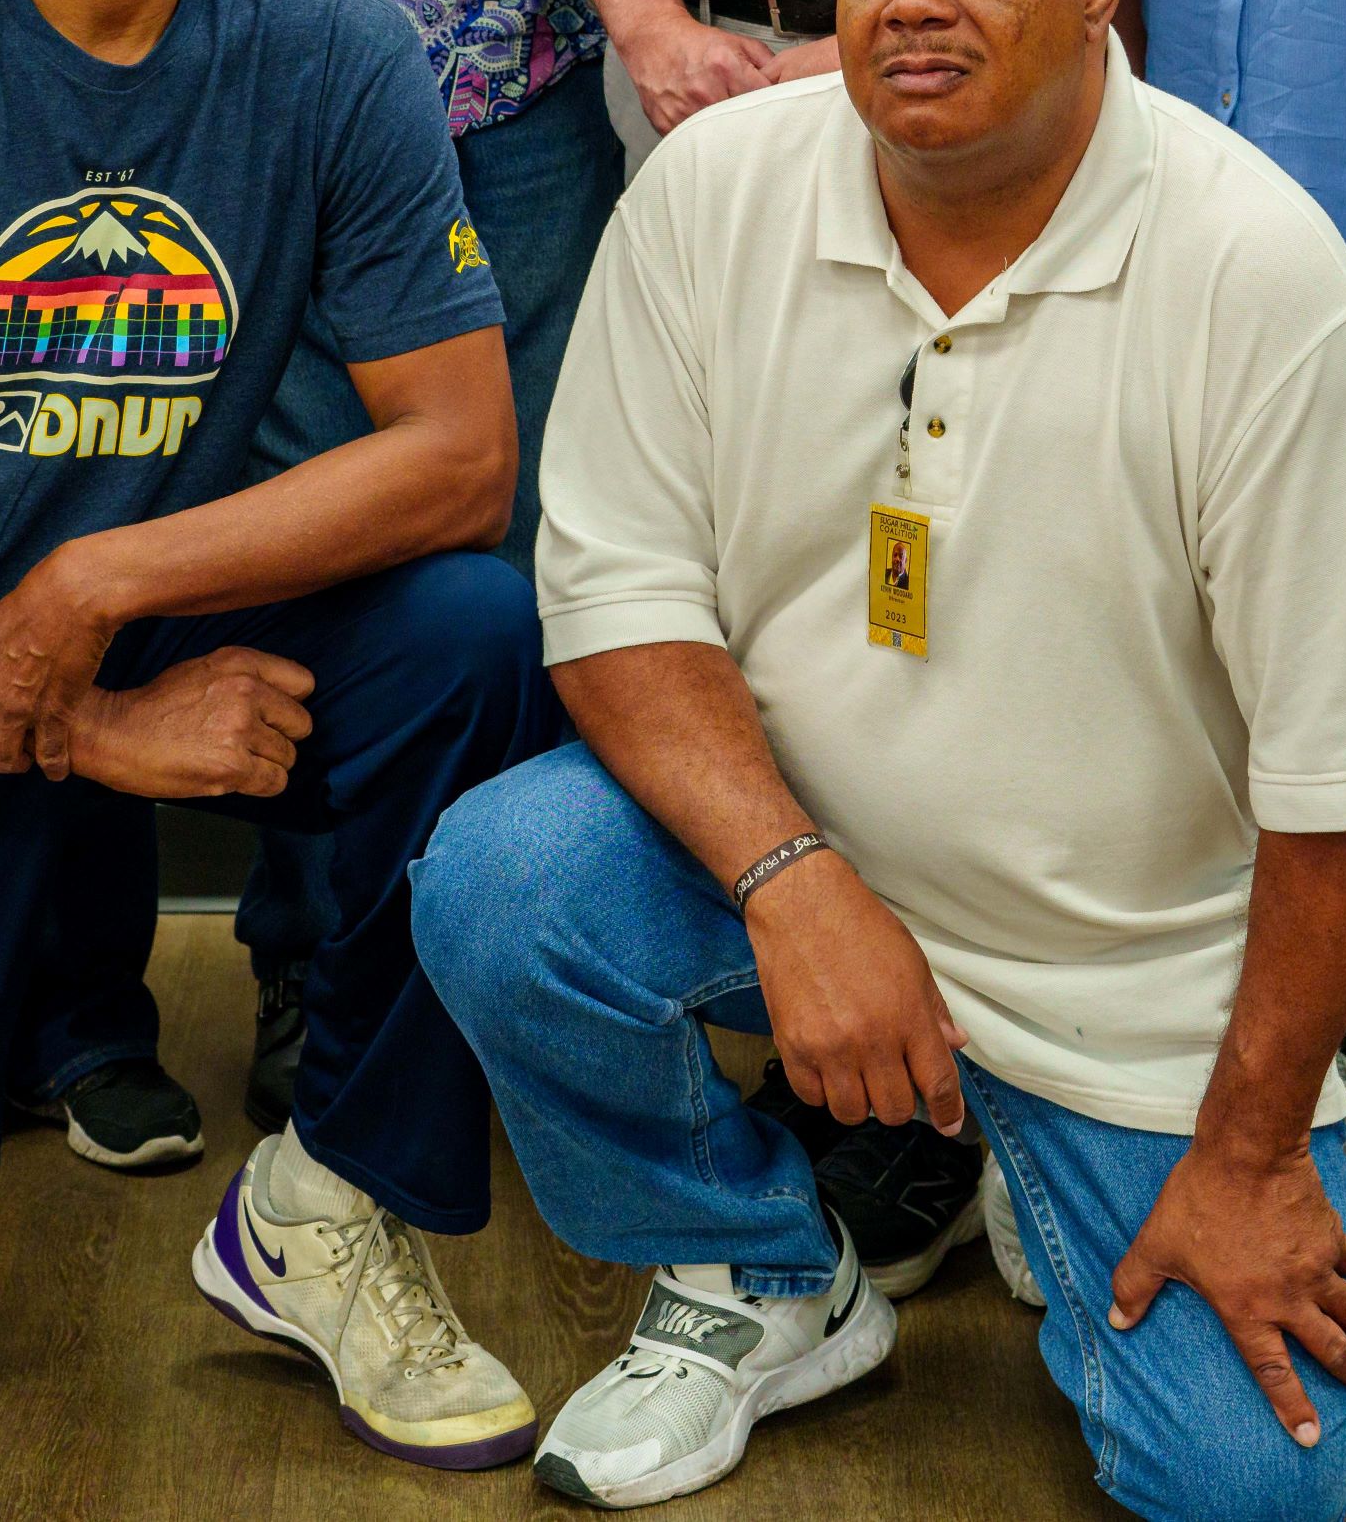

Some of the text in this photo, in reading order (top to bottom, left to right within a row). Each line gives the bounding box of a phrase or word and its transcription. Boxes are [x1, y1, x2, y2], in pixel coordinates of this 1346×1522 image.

[85, 170, 112, 183] EST
[880, 516, 899, 528] SUGAR
[879, 524, 918, 541] COALITION
[885, 609, 907, 624] 2023
[753, 854, 780, 879] PRAY
[656, 1299, 729, 1343] NIKE
